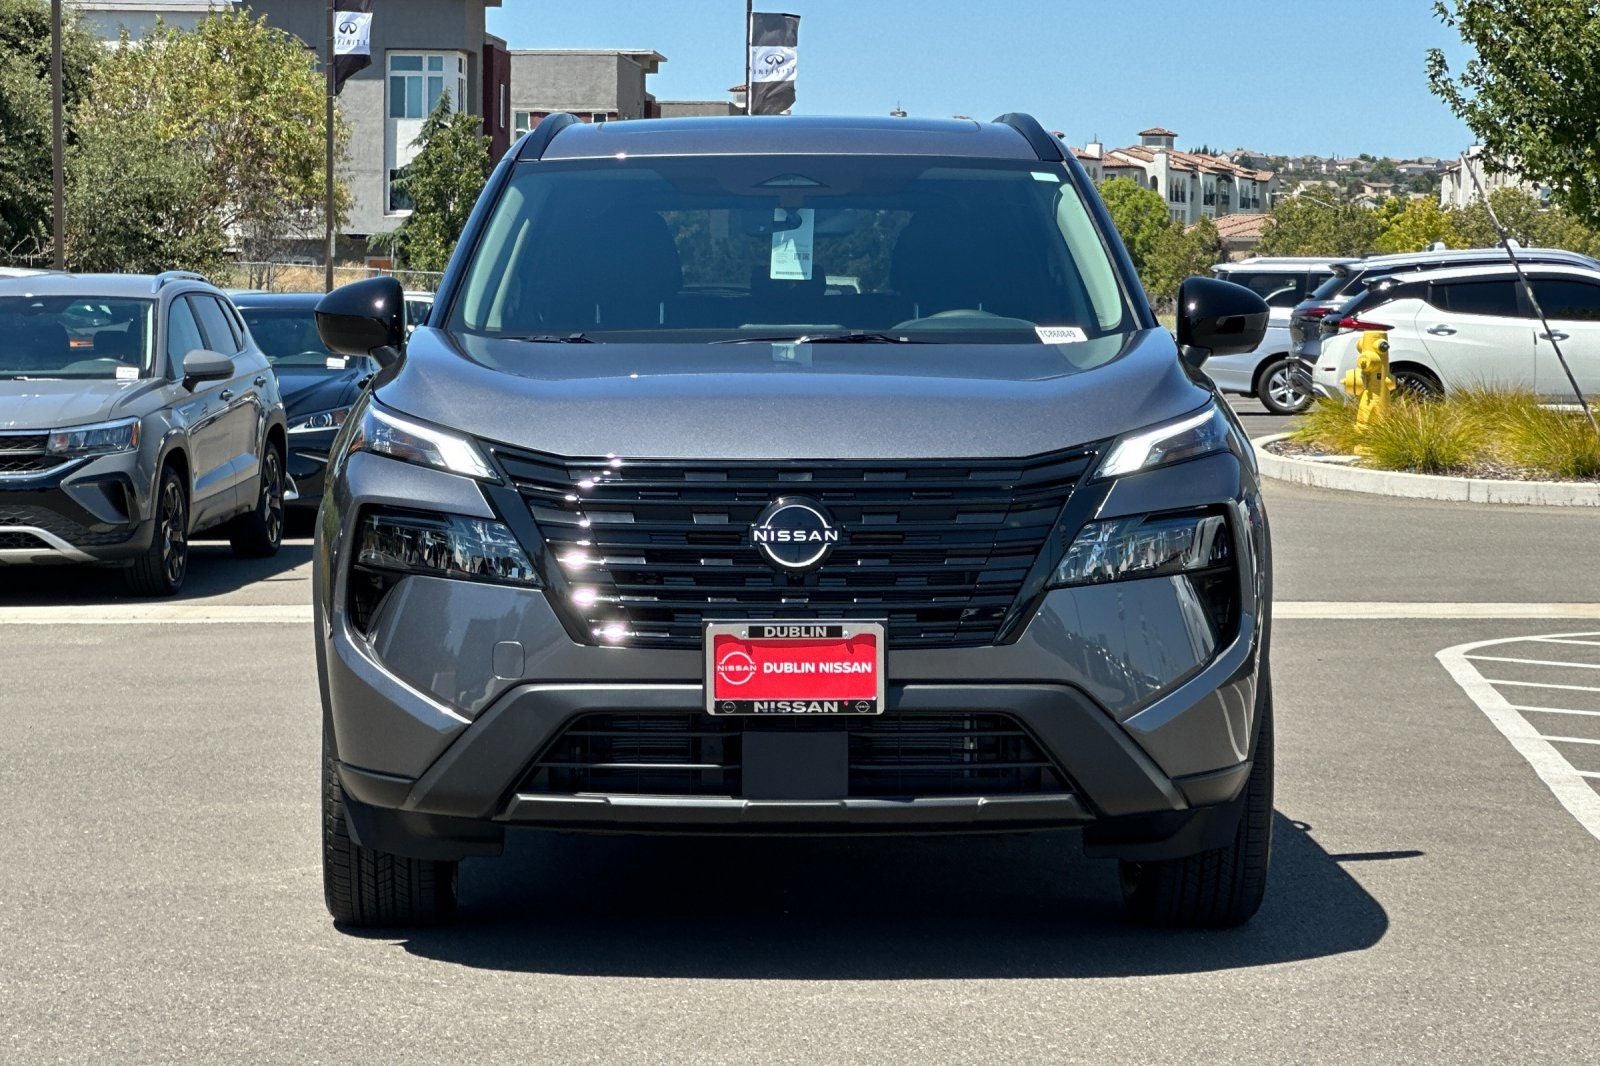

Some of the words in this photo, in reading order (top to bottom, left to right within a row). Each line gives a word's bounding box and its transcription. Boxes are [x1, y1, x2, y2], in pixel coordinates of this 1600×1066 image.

[753, 530, 838, 542] NISSAN
[763, 626, 827, 638] DUBLIN
[763, 662, 815, 674] DUBLIN
[819, 662, 872, 674] NISSAN
[753, 701, 839, 713] NISSAN
